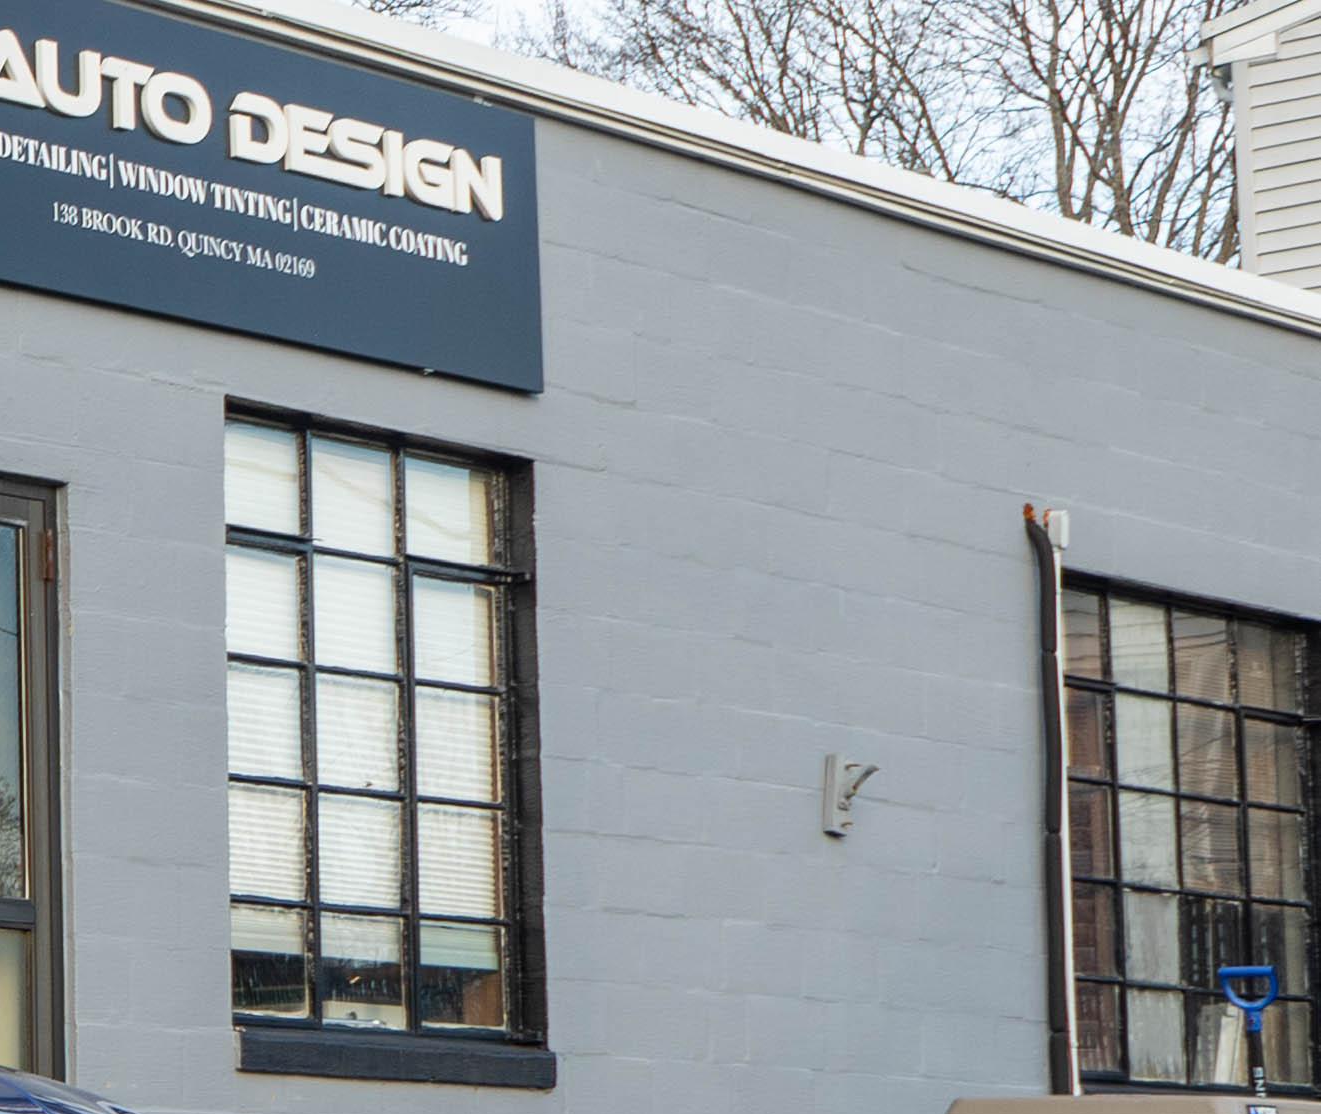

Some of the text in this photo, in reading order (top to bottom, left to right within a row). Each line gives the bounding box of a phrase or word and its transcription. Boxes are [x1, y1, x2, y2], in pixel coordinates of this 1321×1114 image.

[229, 91, 504, 222] DESIGN
[52, 201, 316, 279] 138 BROOK RD. QUINCY MA 02169
[117, 160, 210, 205] WINDOW
[210, 182, 292, 224] TINTING
[300, 204, 389, 247] CERAMIC
[389, 225, 469, 266] COATING
